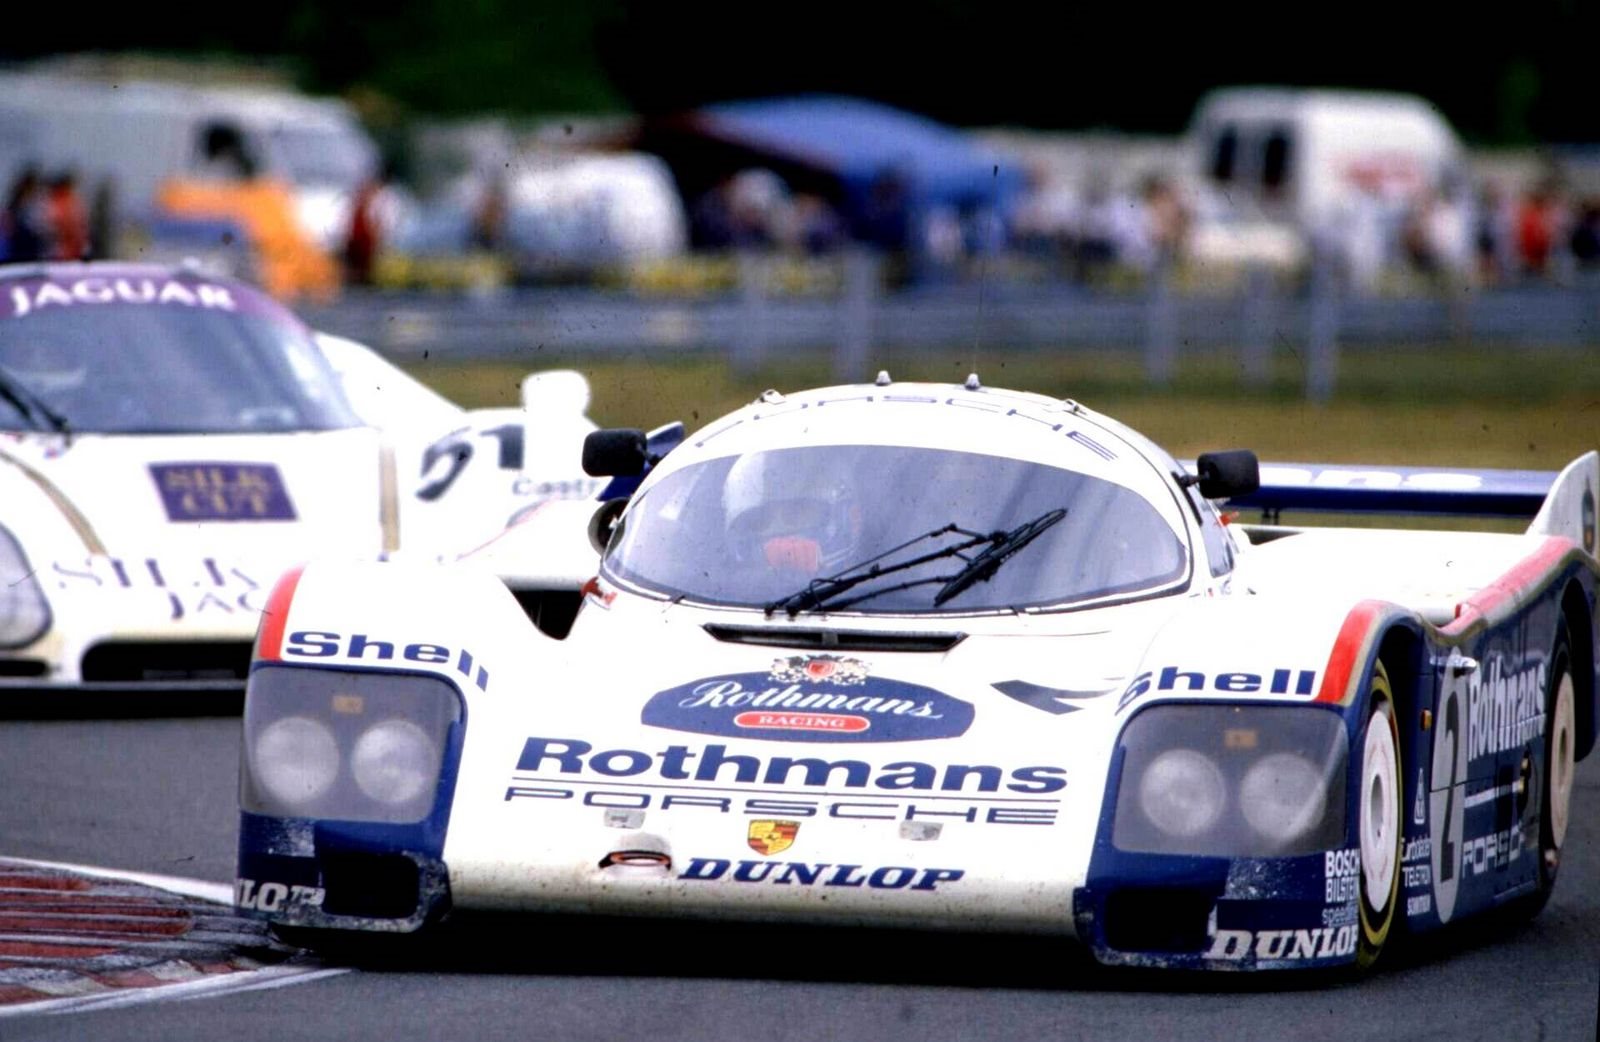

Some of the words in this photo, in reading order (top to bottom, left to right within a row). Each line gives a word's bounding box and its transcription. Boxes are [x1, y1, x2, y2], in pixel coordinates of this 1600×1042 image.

[12, 278, 237, 317] JAGUAR
[511, 476, 600, 499] Castr
[286, 630, 490, 693] Shell
[678, 679, 945, 720] Rothmans
[1114, 666, 1317, 717] Shell
[1467, 653, 1546, 762] Rothmans
[758, 713, 847, 729] RACING
[515, 736, 1069, 794] Rothmans
[504, 785, 1061, 826] PORSCHE
[677, 856, 966, 891] DUNLOP
